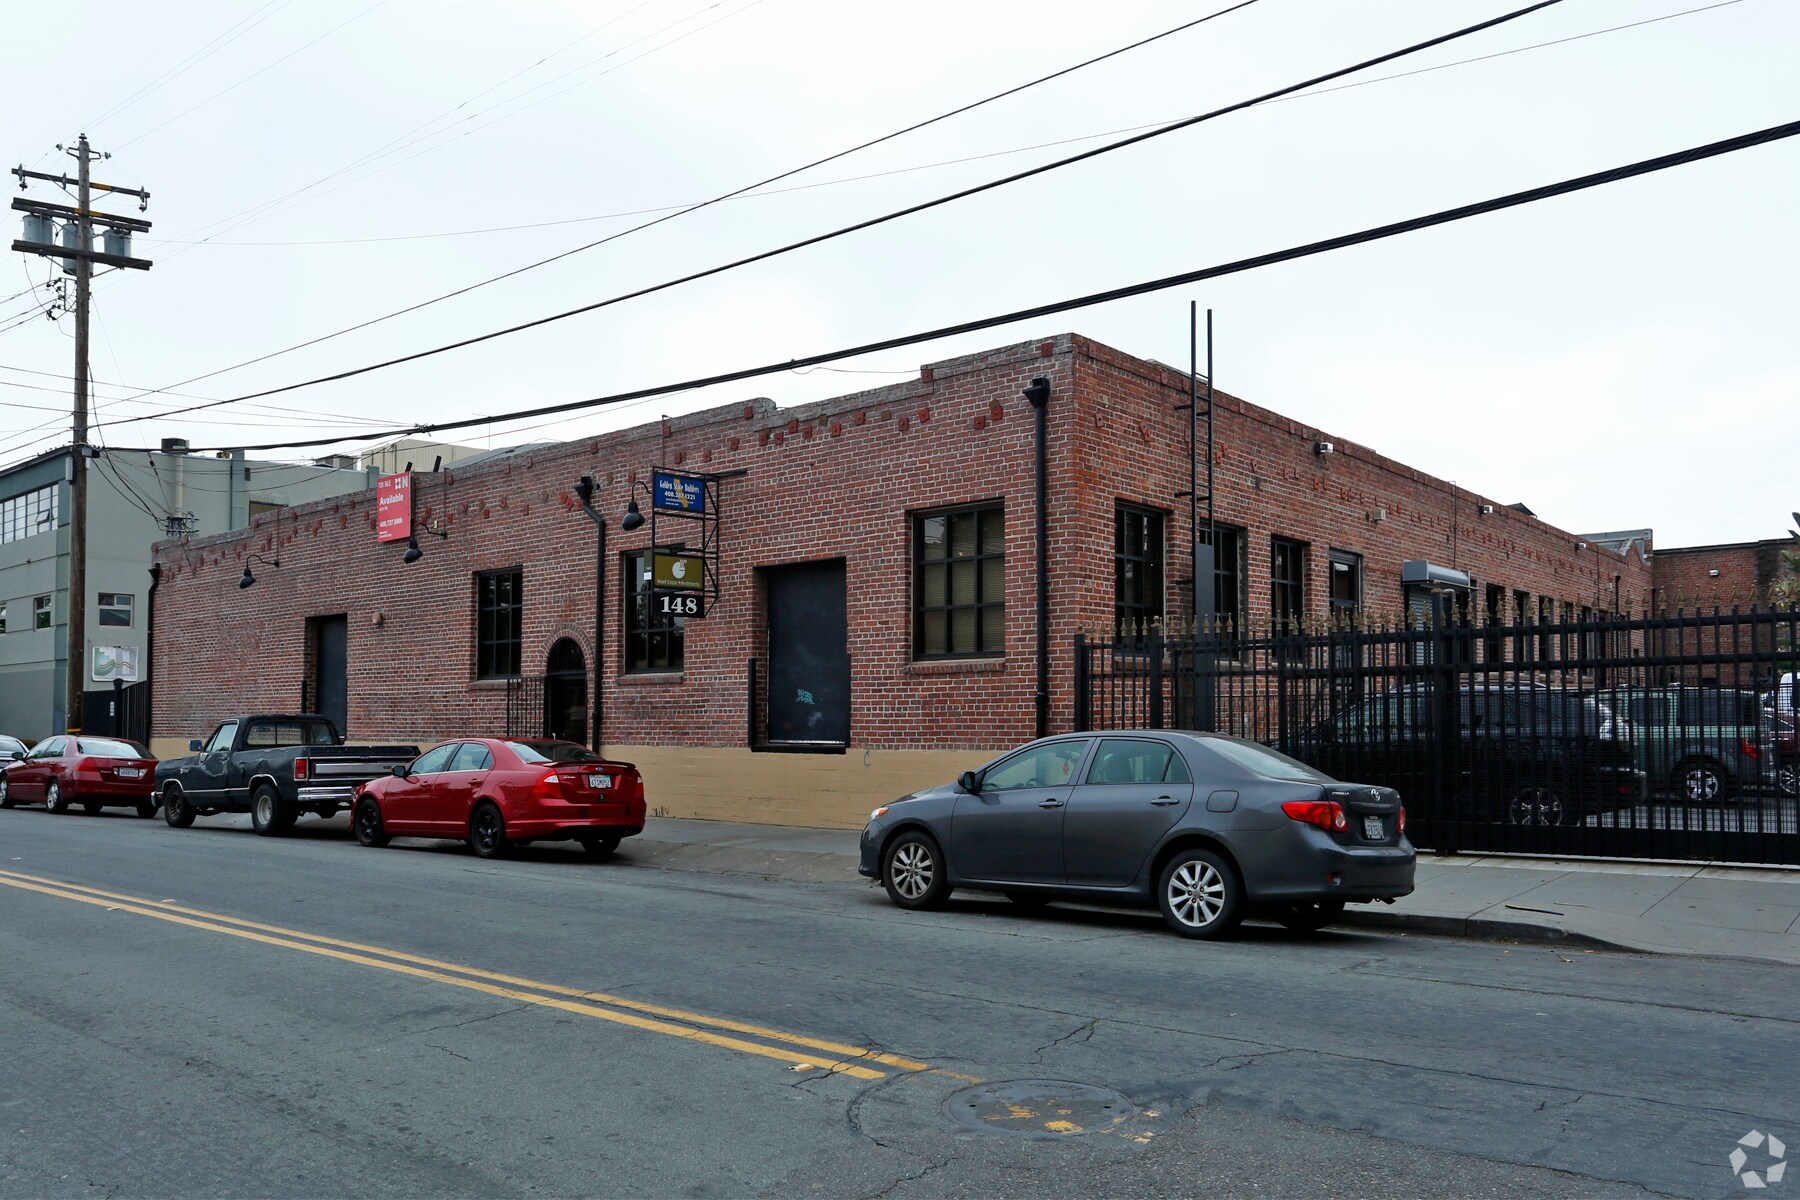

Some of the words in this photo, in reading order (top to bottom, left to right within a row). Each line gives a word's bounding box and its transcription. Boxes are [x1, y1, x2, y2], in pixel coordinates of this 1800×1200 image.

[659, 480, 673, 490] Golden
[684, 483, 700, 493] Builders
[380, 493, 403, 505] Available
[660, 596, 698, 614] 148
